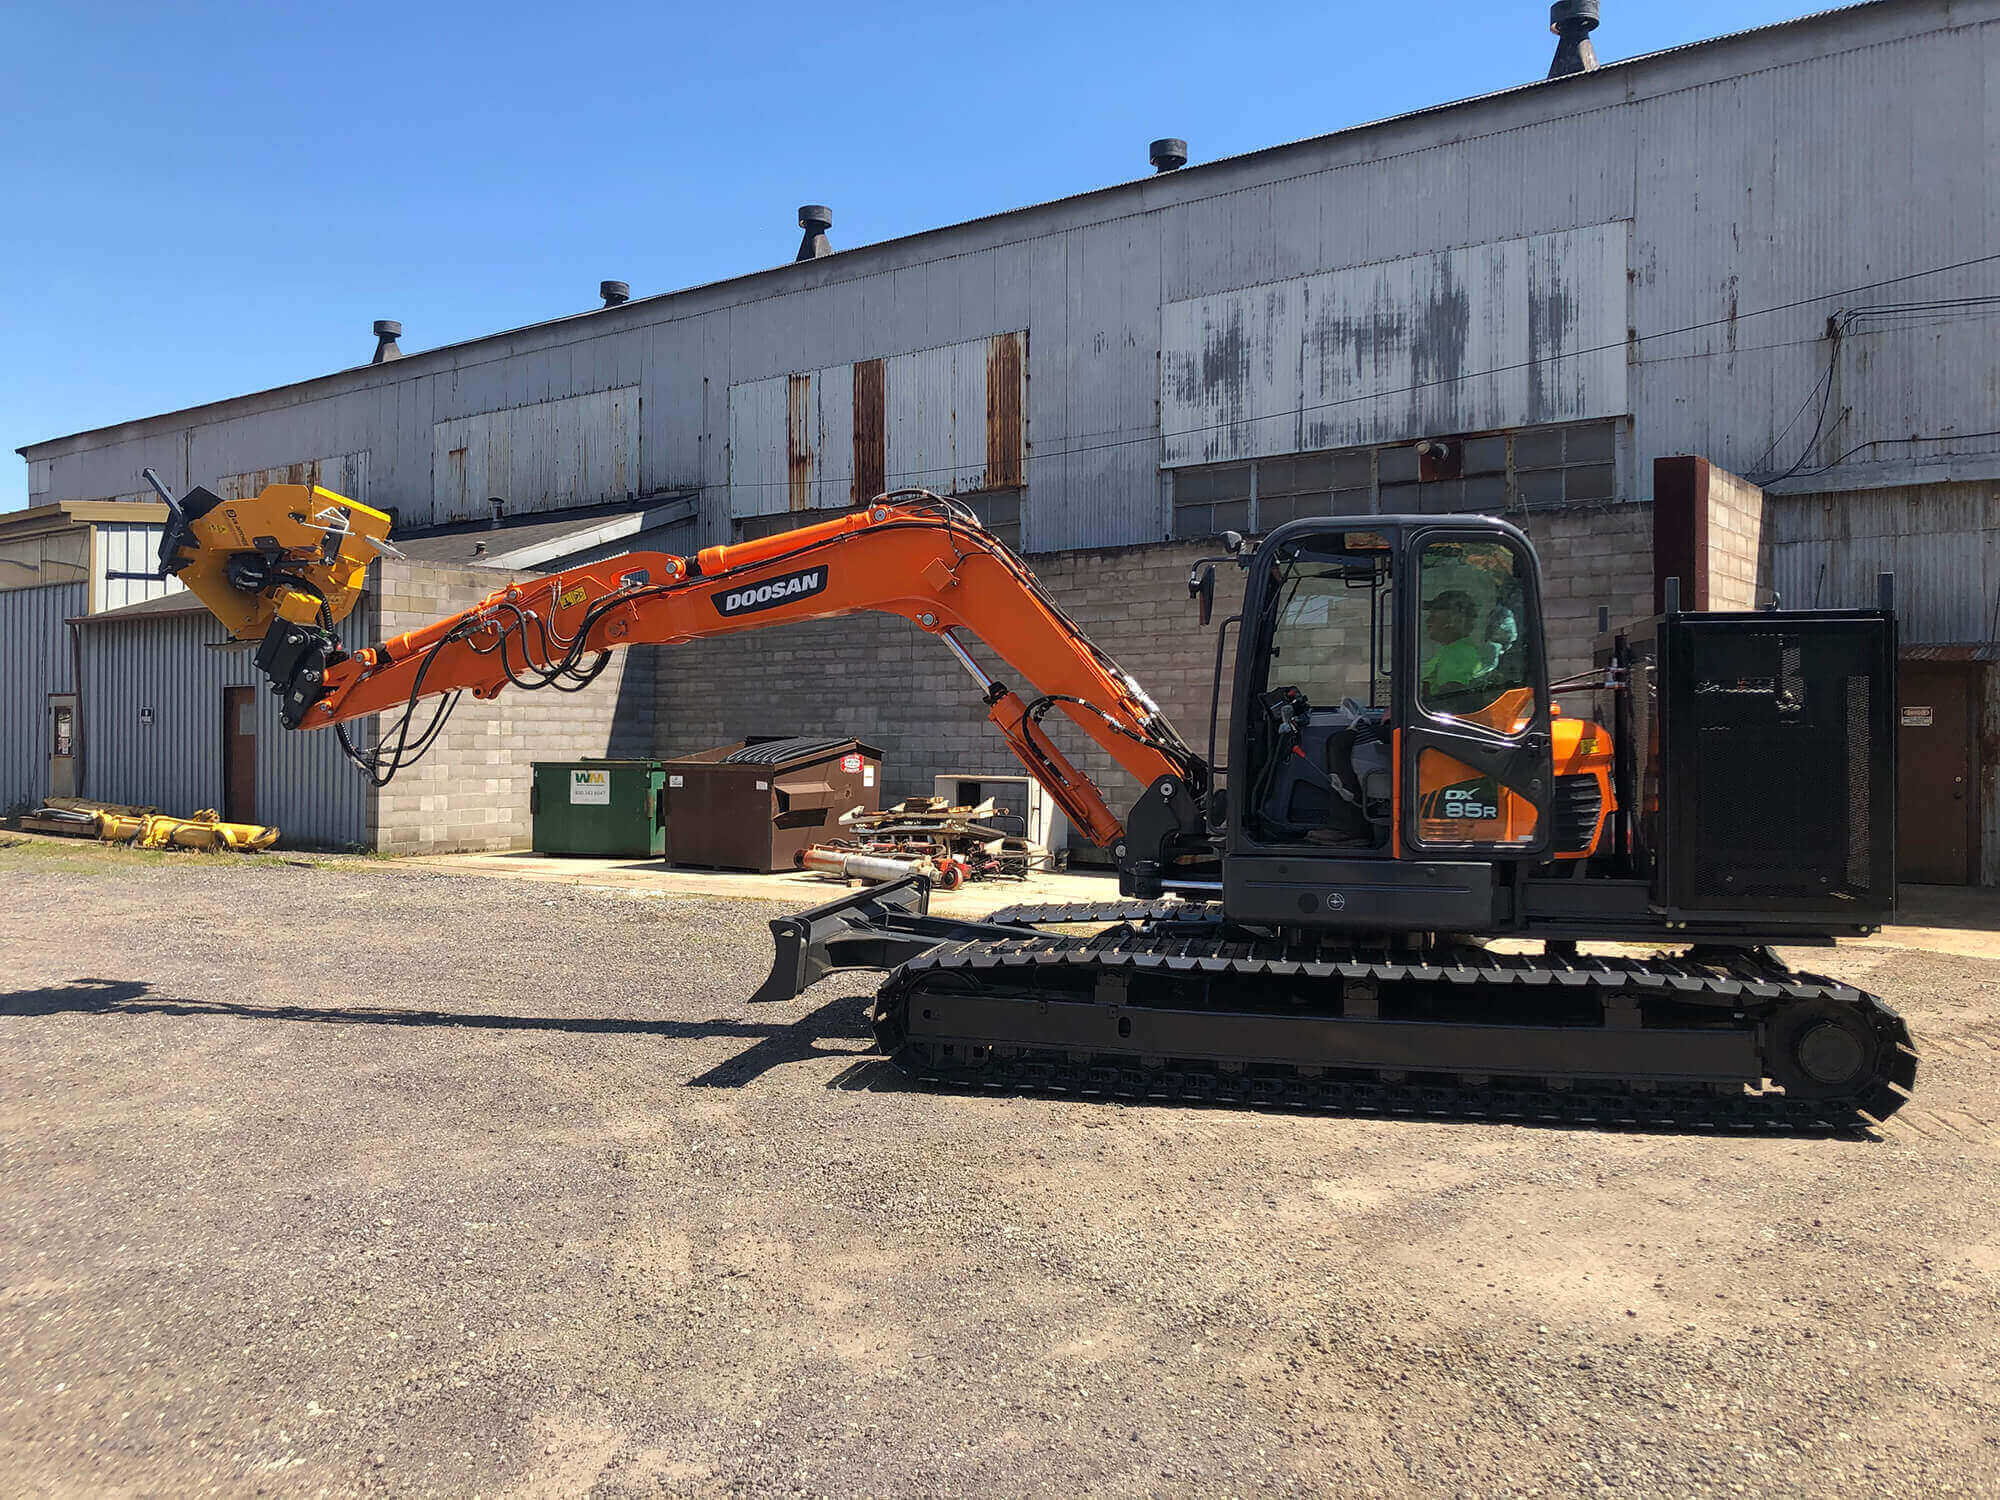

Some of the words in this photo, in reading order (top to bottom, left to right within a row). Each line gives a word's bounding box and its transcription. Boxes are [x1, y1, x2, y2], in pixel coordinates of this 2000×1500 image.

[726, 573, 818, 611] DOOSAN
[575, 772, 605, 784] WM
[1445, 787, 1480, 800] DX
[1445, 802, 1497, 818] 85R
